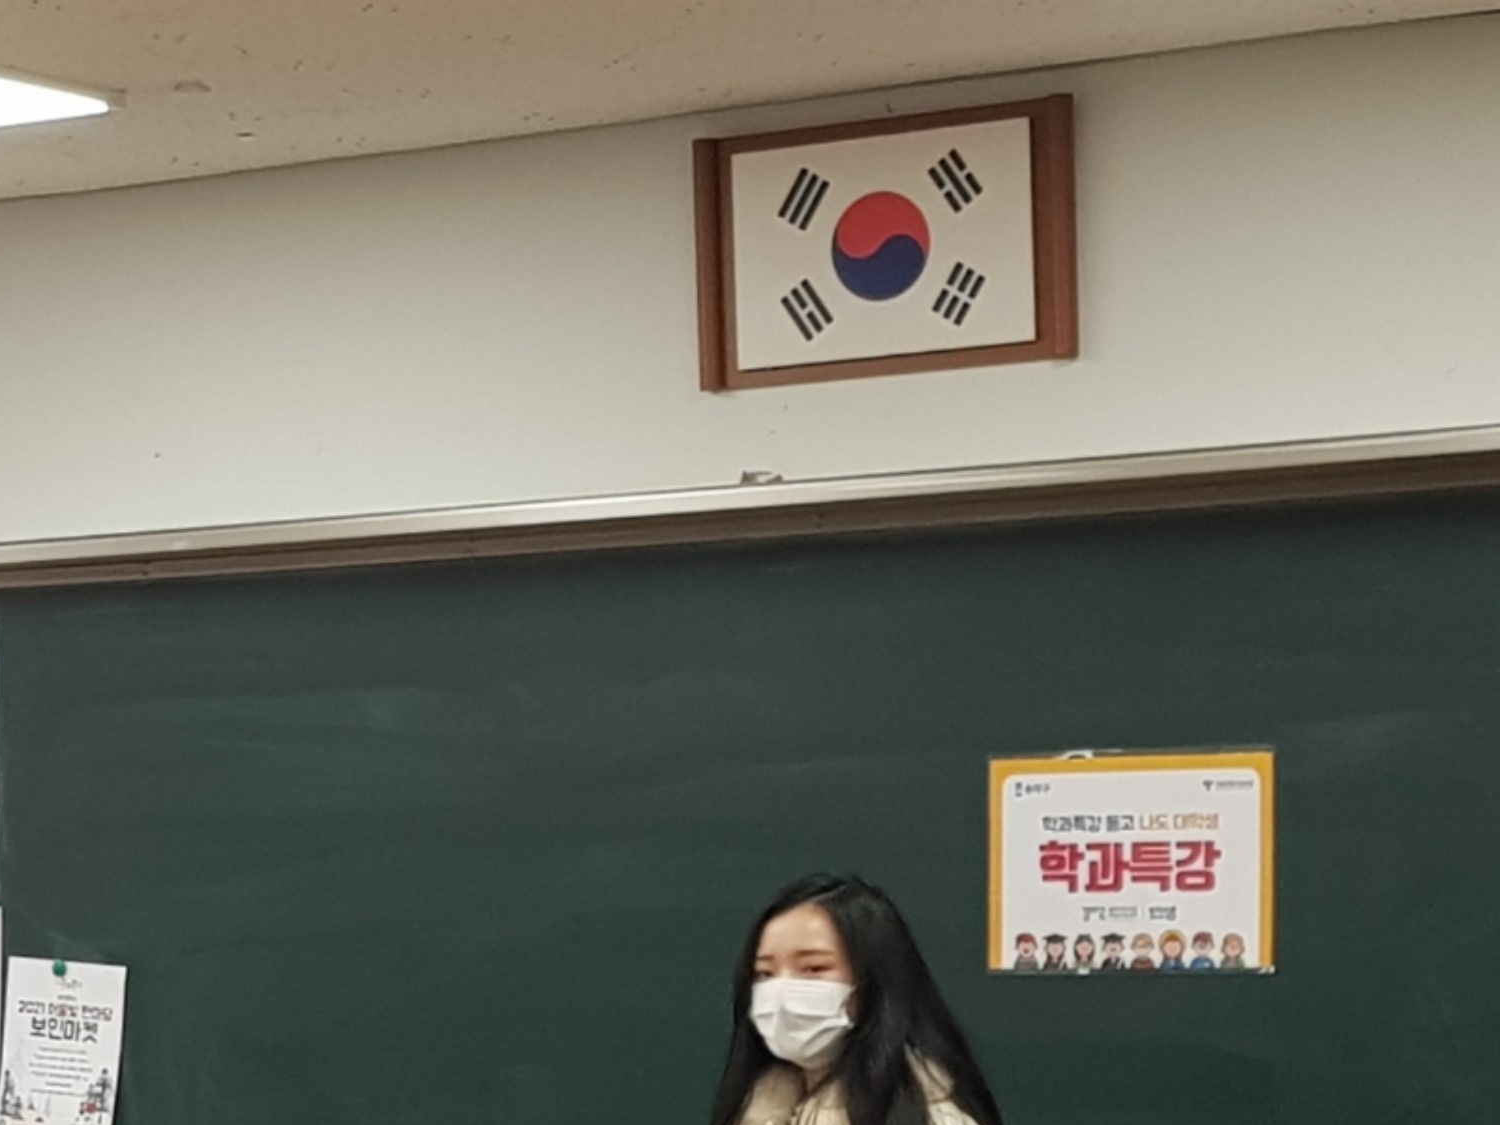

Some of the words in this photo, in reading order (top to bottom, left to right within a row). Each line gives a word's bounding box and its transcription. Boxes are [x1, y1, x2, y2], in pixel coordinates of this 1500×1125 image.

[1042, 814, 1103, 834] 학과특강
[1139, 813, 1170, 832] 나도
[1173, 811, 1220, 831] 대학생
[1038, 840, 1222, 893] 학과특강
[29, 1016, 98, 1044] 보인마켓
